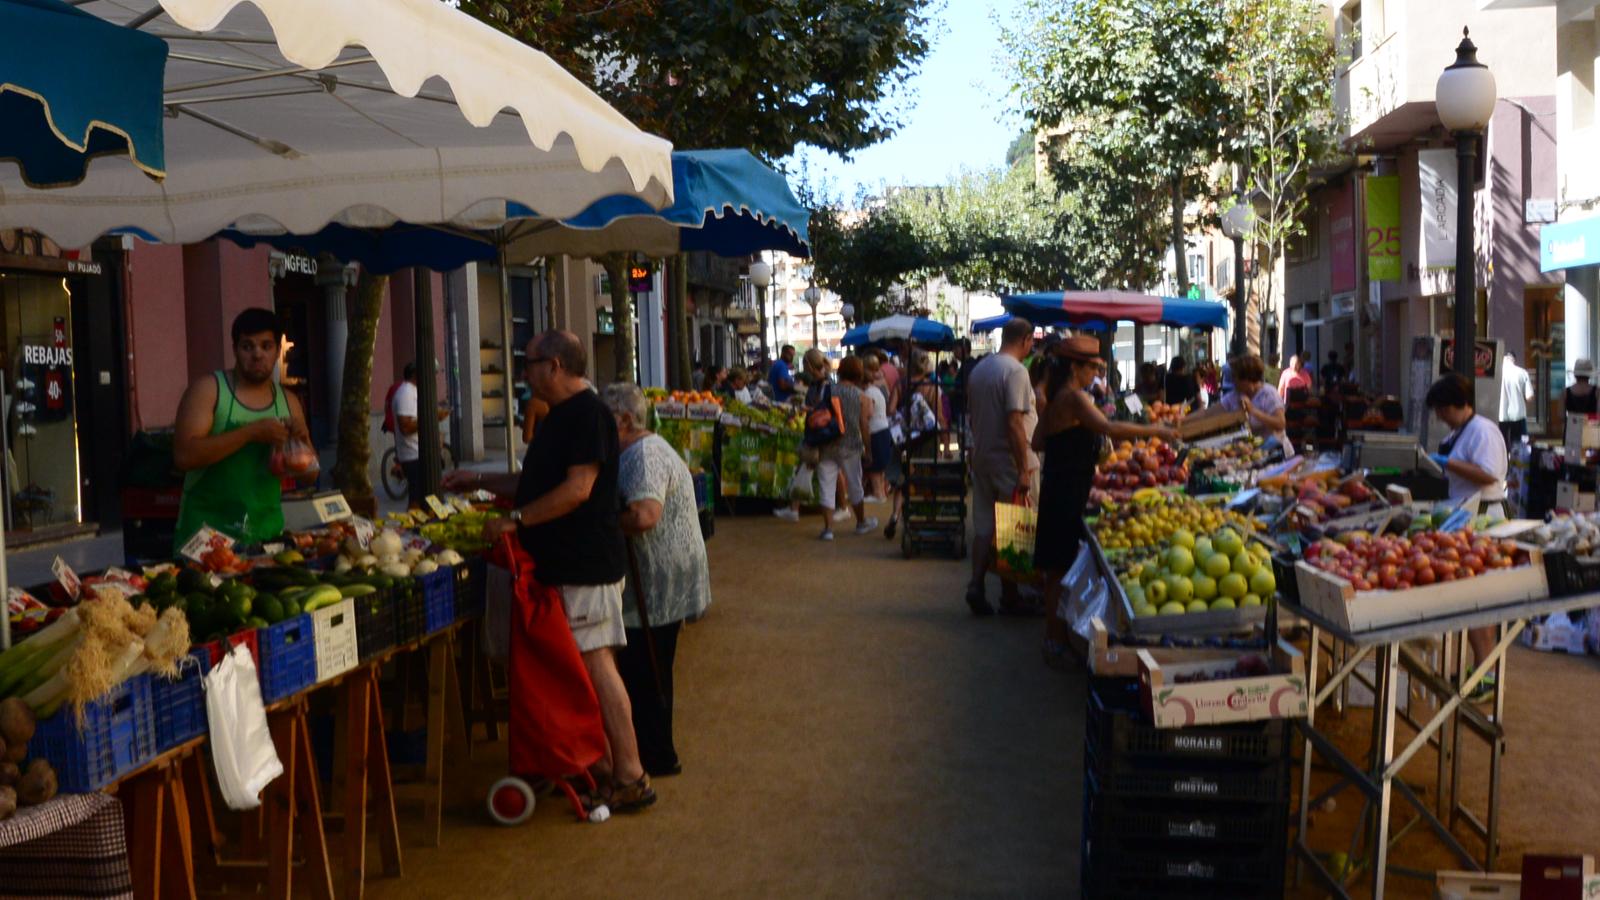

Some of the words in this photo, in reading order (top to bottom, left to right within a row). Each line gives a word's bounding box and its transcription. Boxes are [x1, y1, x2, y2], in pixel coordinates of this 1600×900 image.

[1367, 227, 1400, 256] 25
[284, 253, 318, 276] NGFIELD
[24, 344, 73, 366] REBAJAS
[1174, 735, 1222, 750] MORALES
